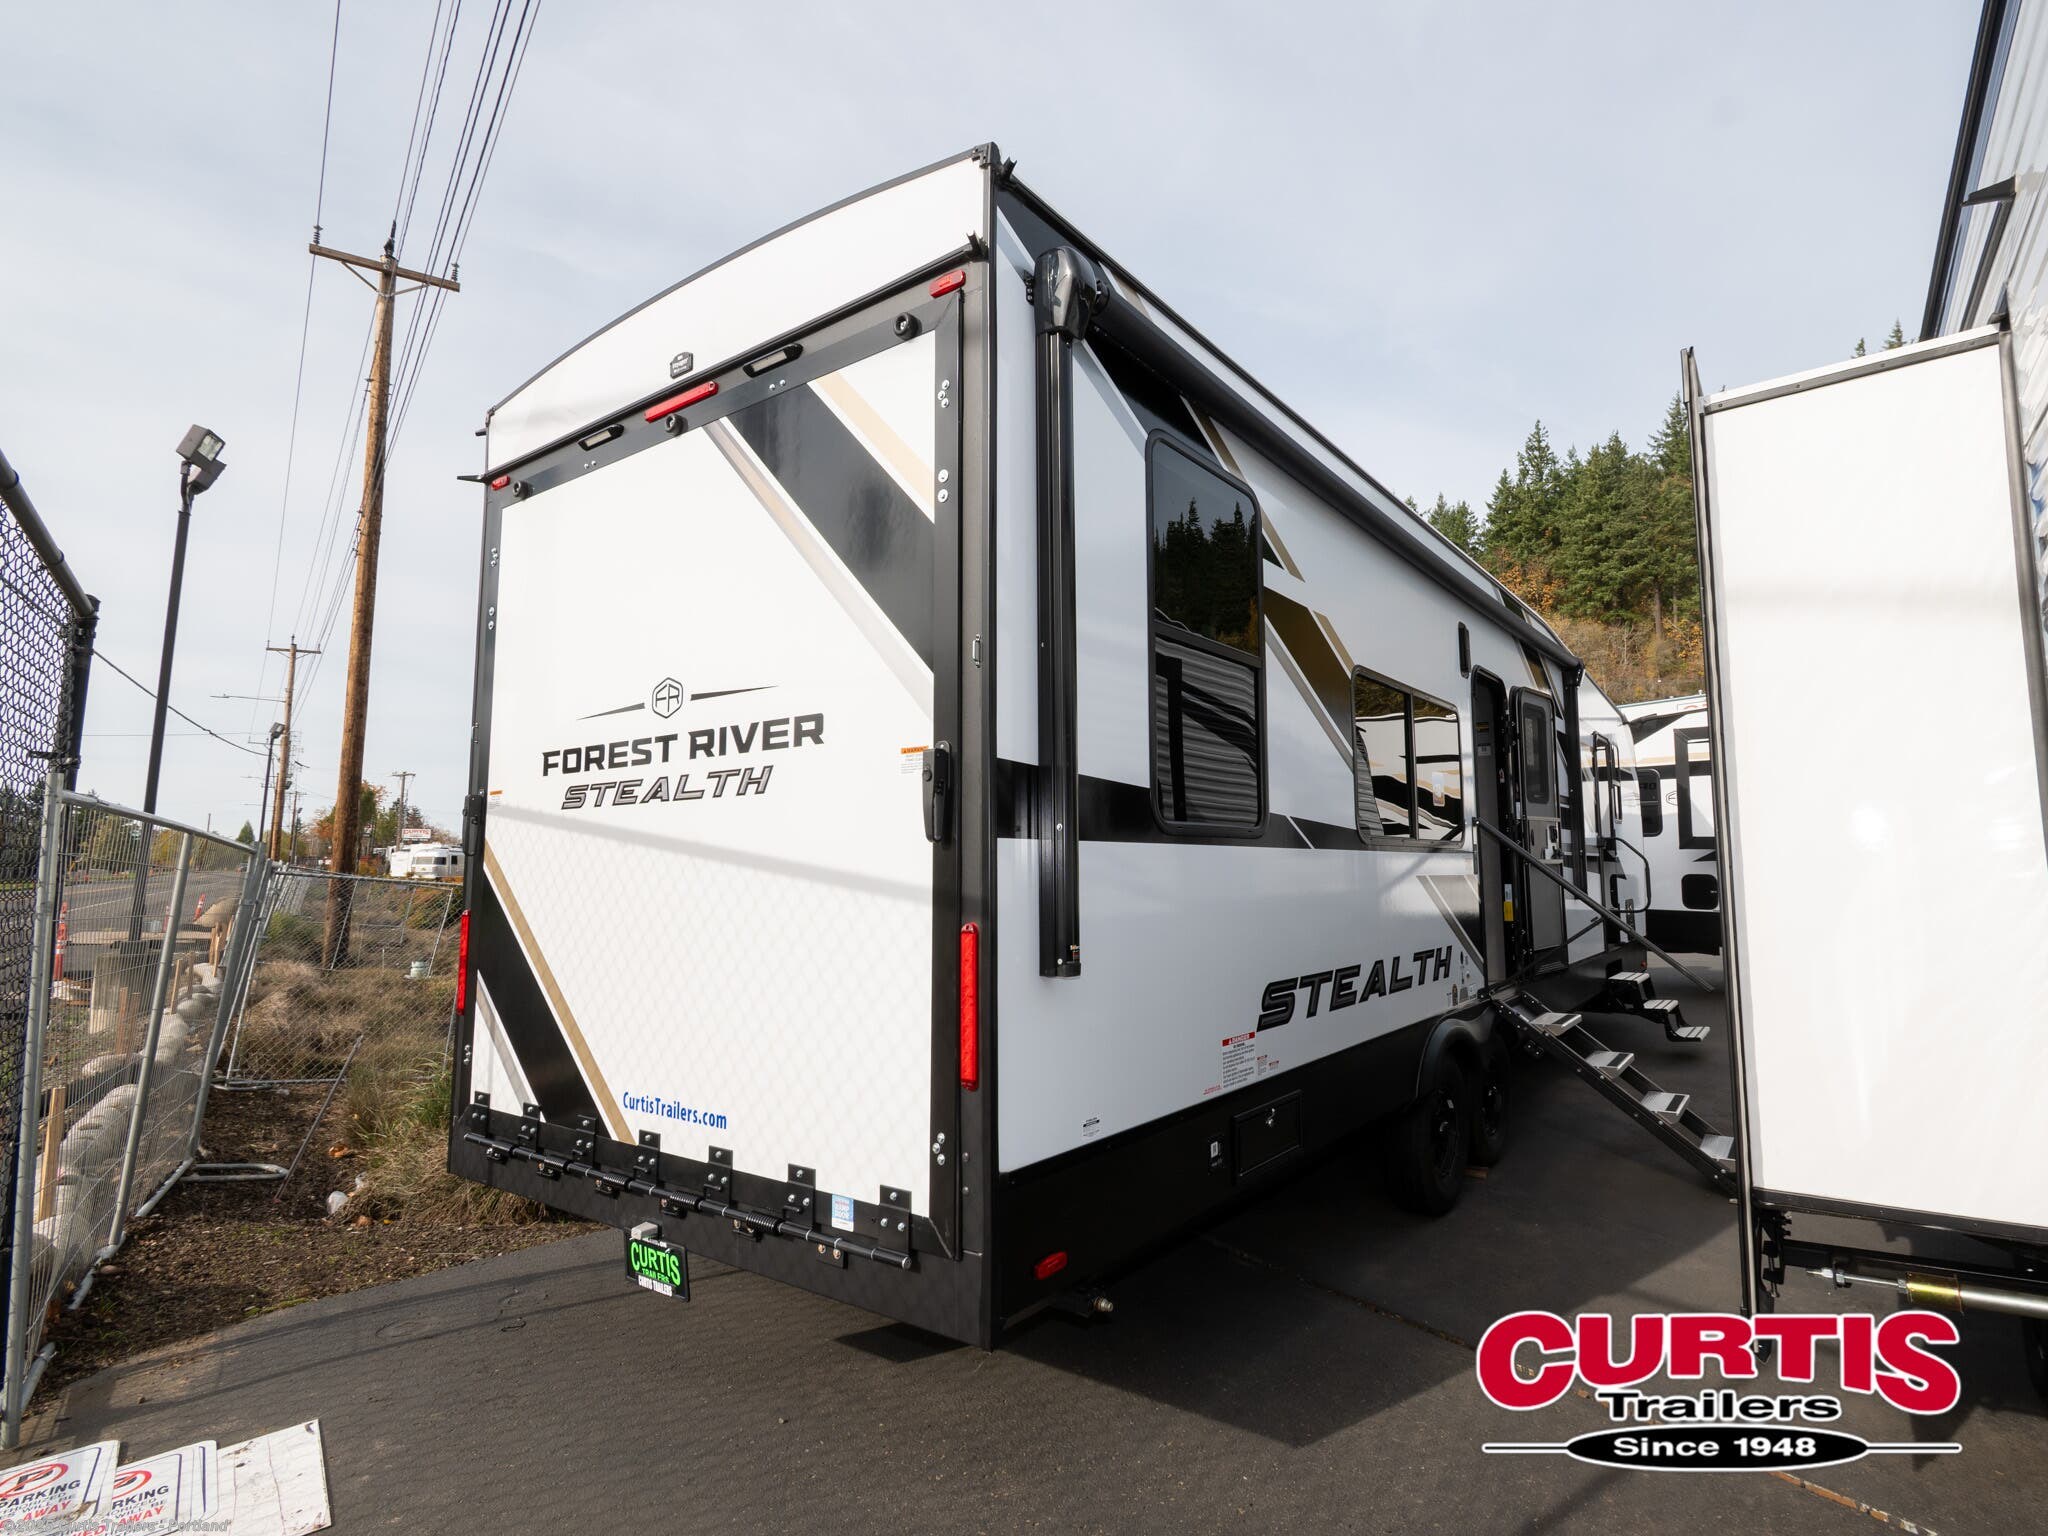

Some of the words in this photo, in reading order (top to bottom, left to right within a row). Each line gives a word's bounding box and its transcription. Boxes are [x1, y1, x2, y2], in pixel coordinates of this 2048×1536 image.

[542, 733, 679, 777] FOREST
[688, 712, 825, 760] RIVER
[561, 764, 774, 810] STEALTH
[1256, 945, 1452, 1032] STEALTH
[622, 1091, 728, 1130] CurtisTrailers.com
[630, 1242, 681, 1286] CURTIS
[23, 1500, 71, 1521] AWAY
[118, 1505, 164, 1525] AWAY
